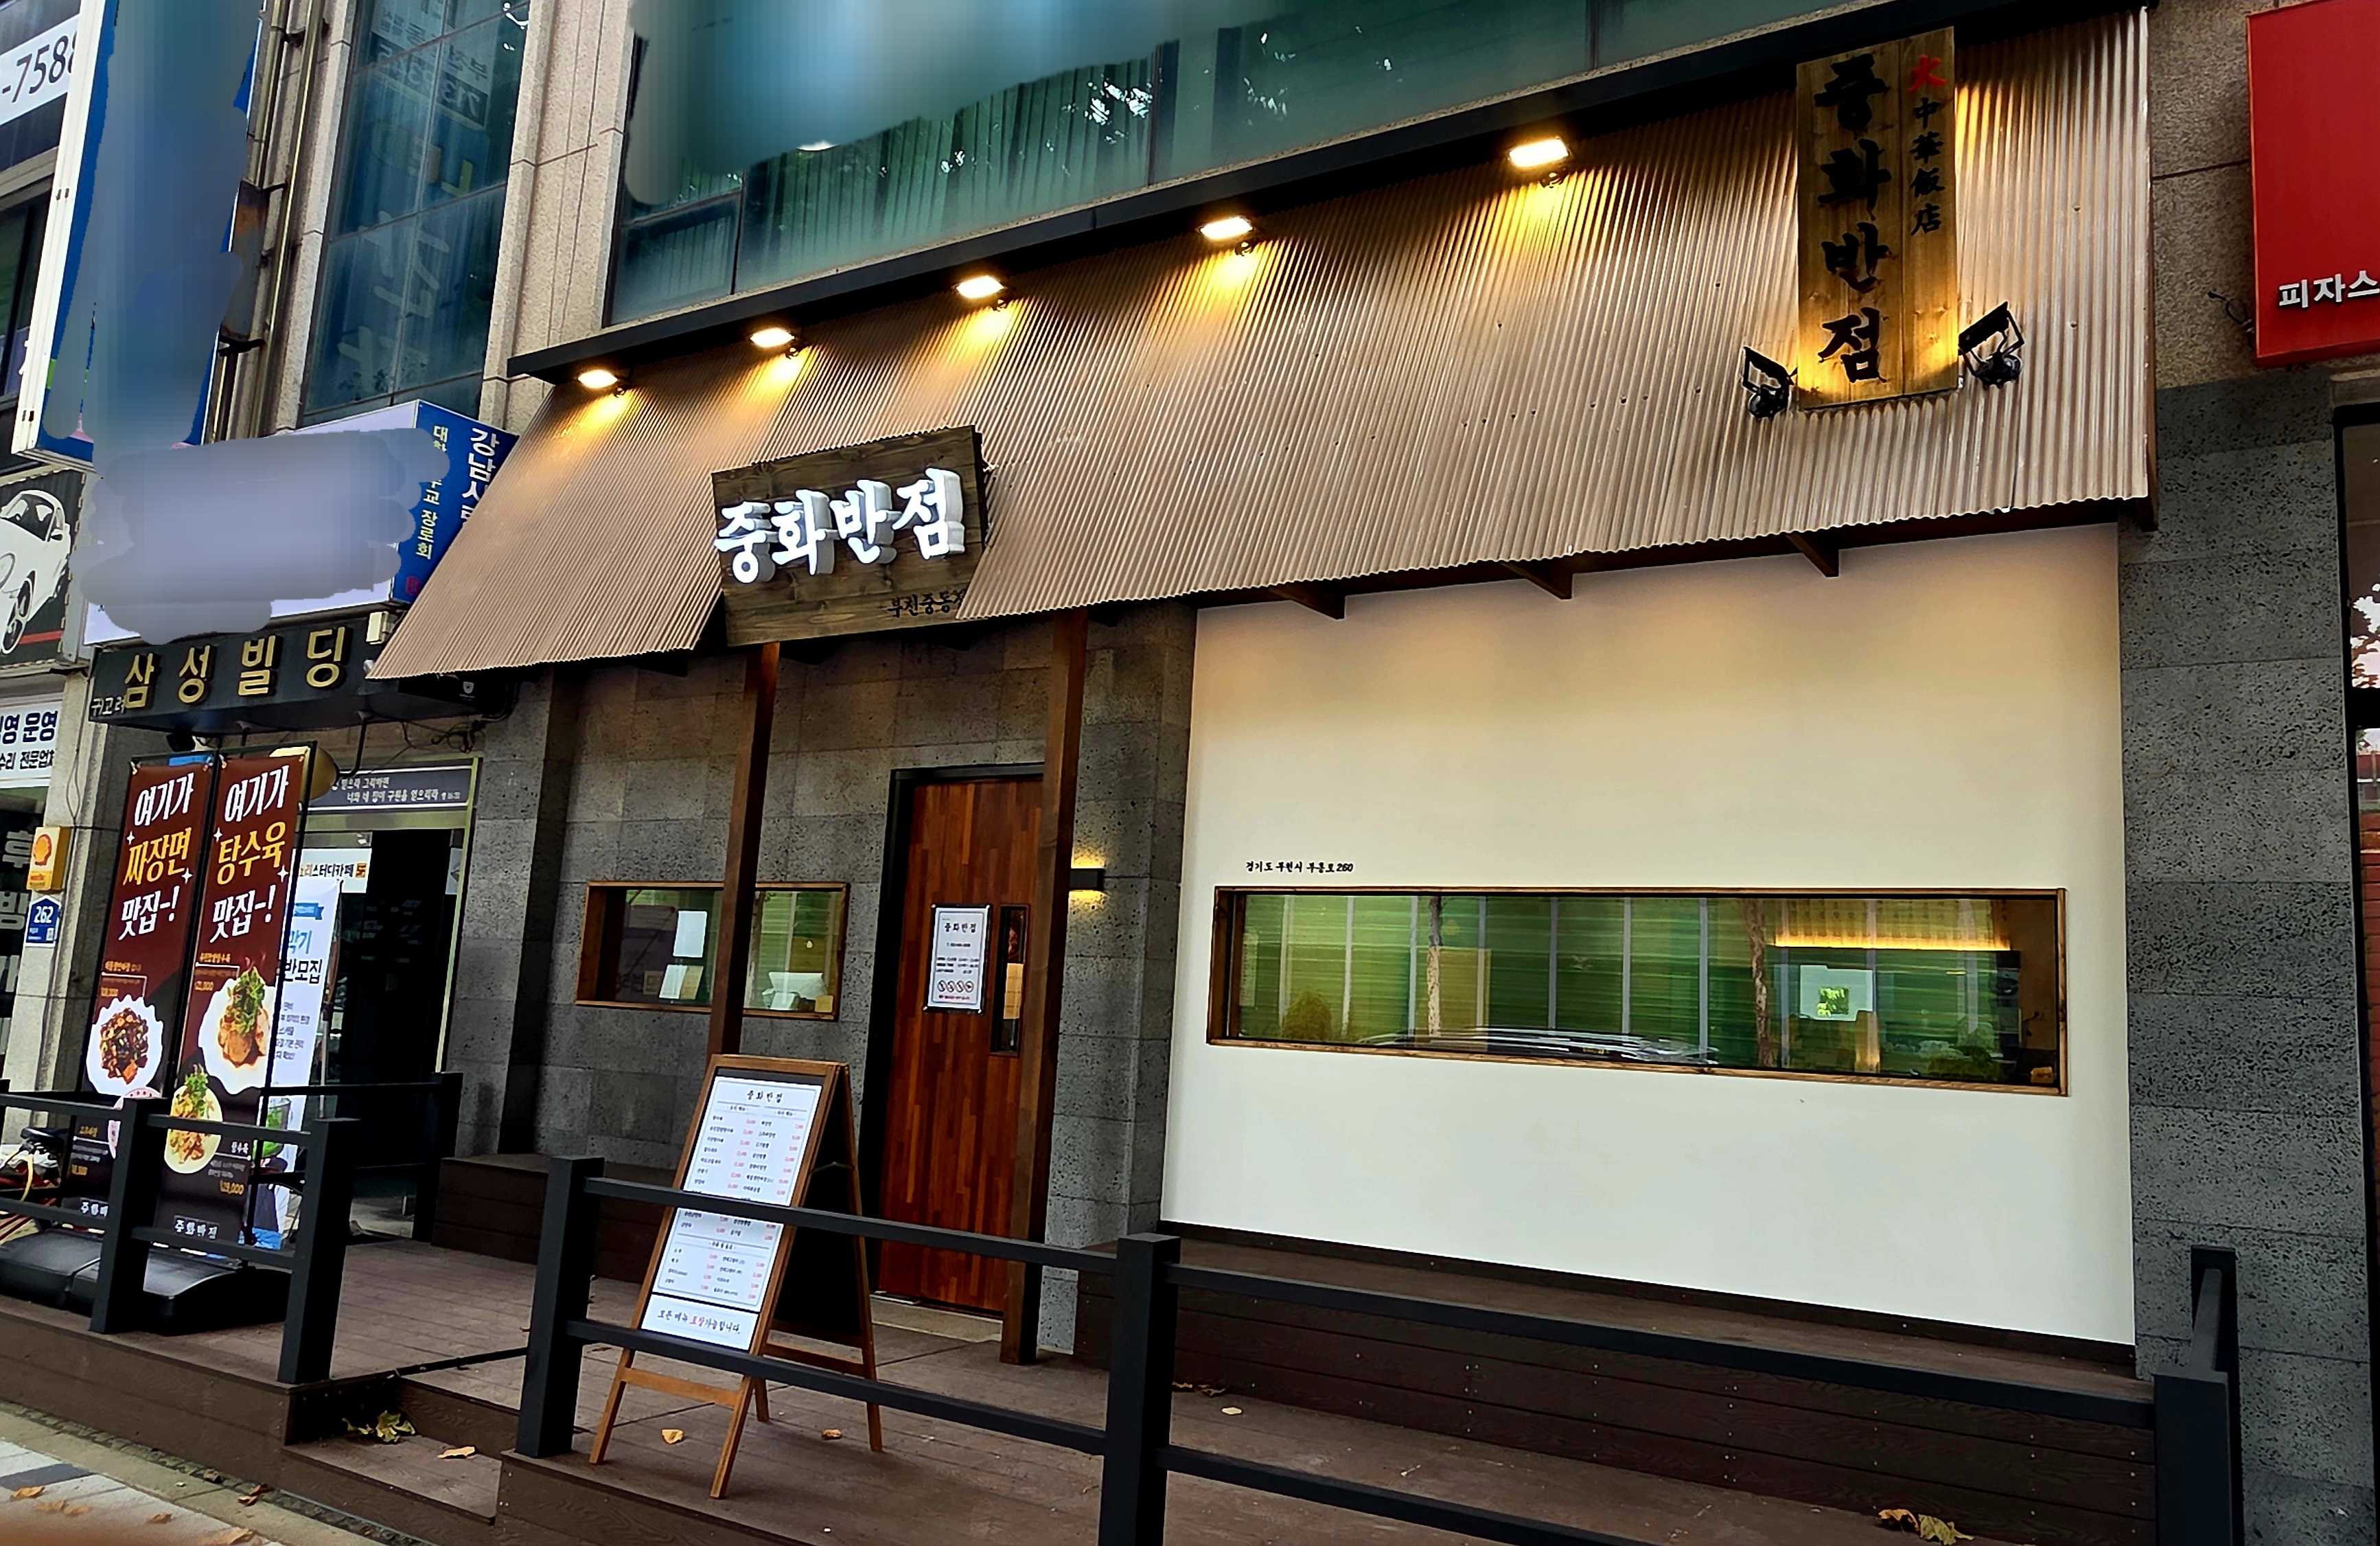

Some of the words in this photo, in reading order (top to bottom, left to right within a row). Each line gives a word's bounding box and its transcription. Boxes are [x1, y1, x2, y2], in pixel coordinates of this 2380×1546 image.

[2, 31, 78, 103] -758
[1813, 53, 1891, 384] 중화반점
[2278, 270, 2380, 308] 피자스
[713, 468, 964, 584] 중화반점
[124, 626, 347, 710] 삼성빌딩
[0, 714, 21, 745] 영
[23, 710, 58, 742] 운영
[134, 772, 194, 827] 여기가
[224, 765, 289, 822] 여기가
[123, 827, 192, 886] 짜장면
[217, 822, 286, 885] 탕수육
[1246, 861, 1273, 873] 경기도
[1275, 861, 1303, 873] 부천시
[34, 905, 54, 924] 262
